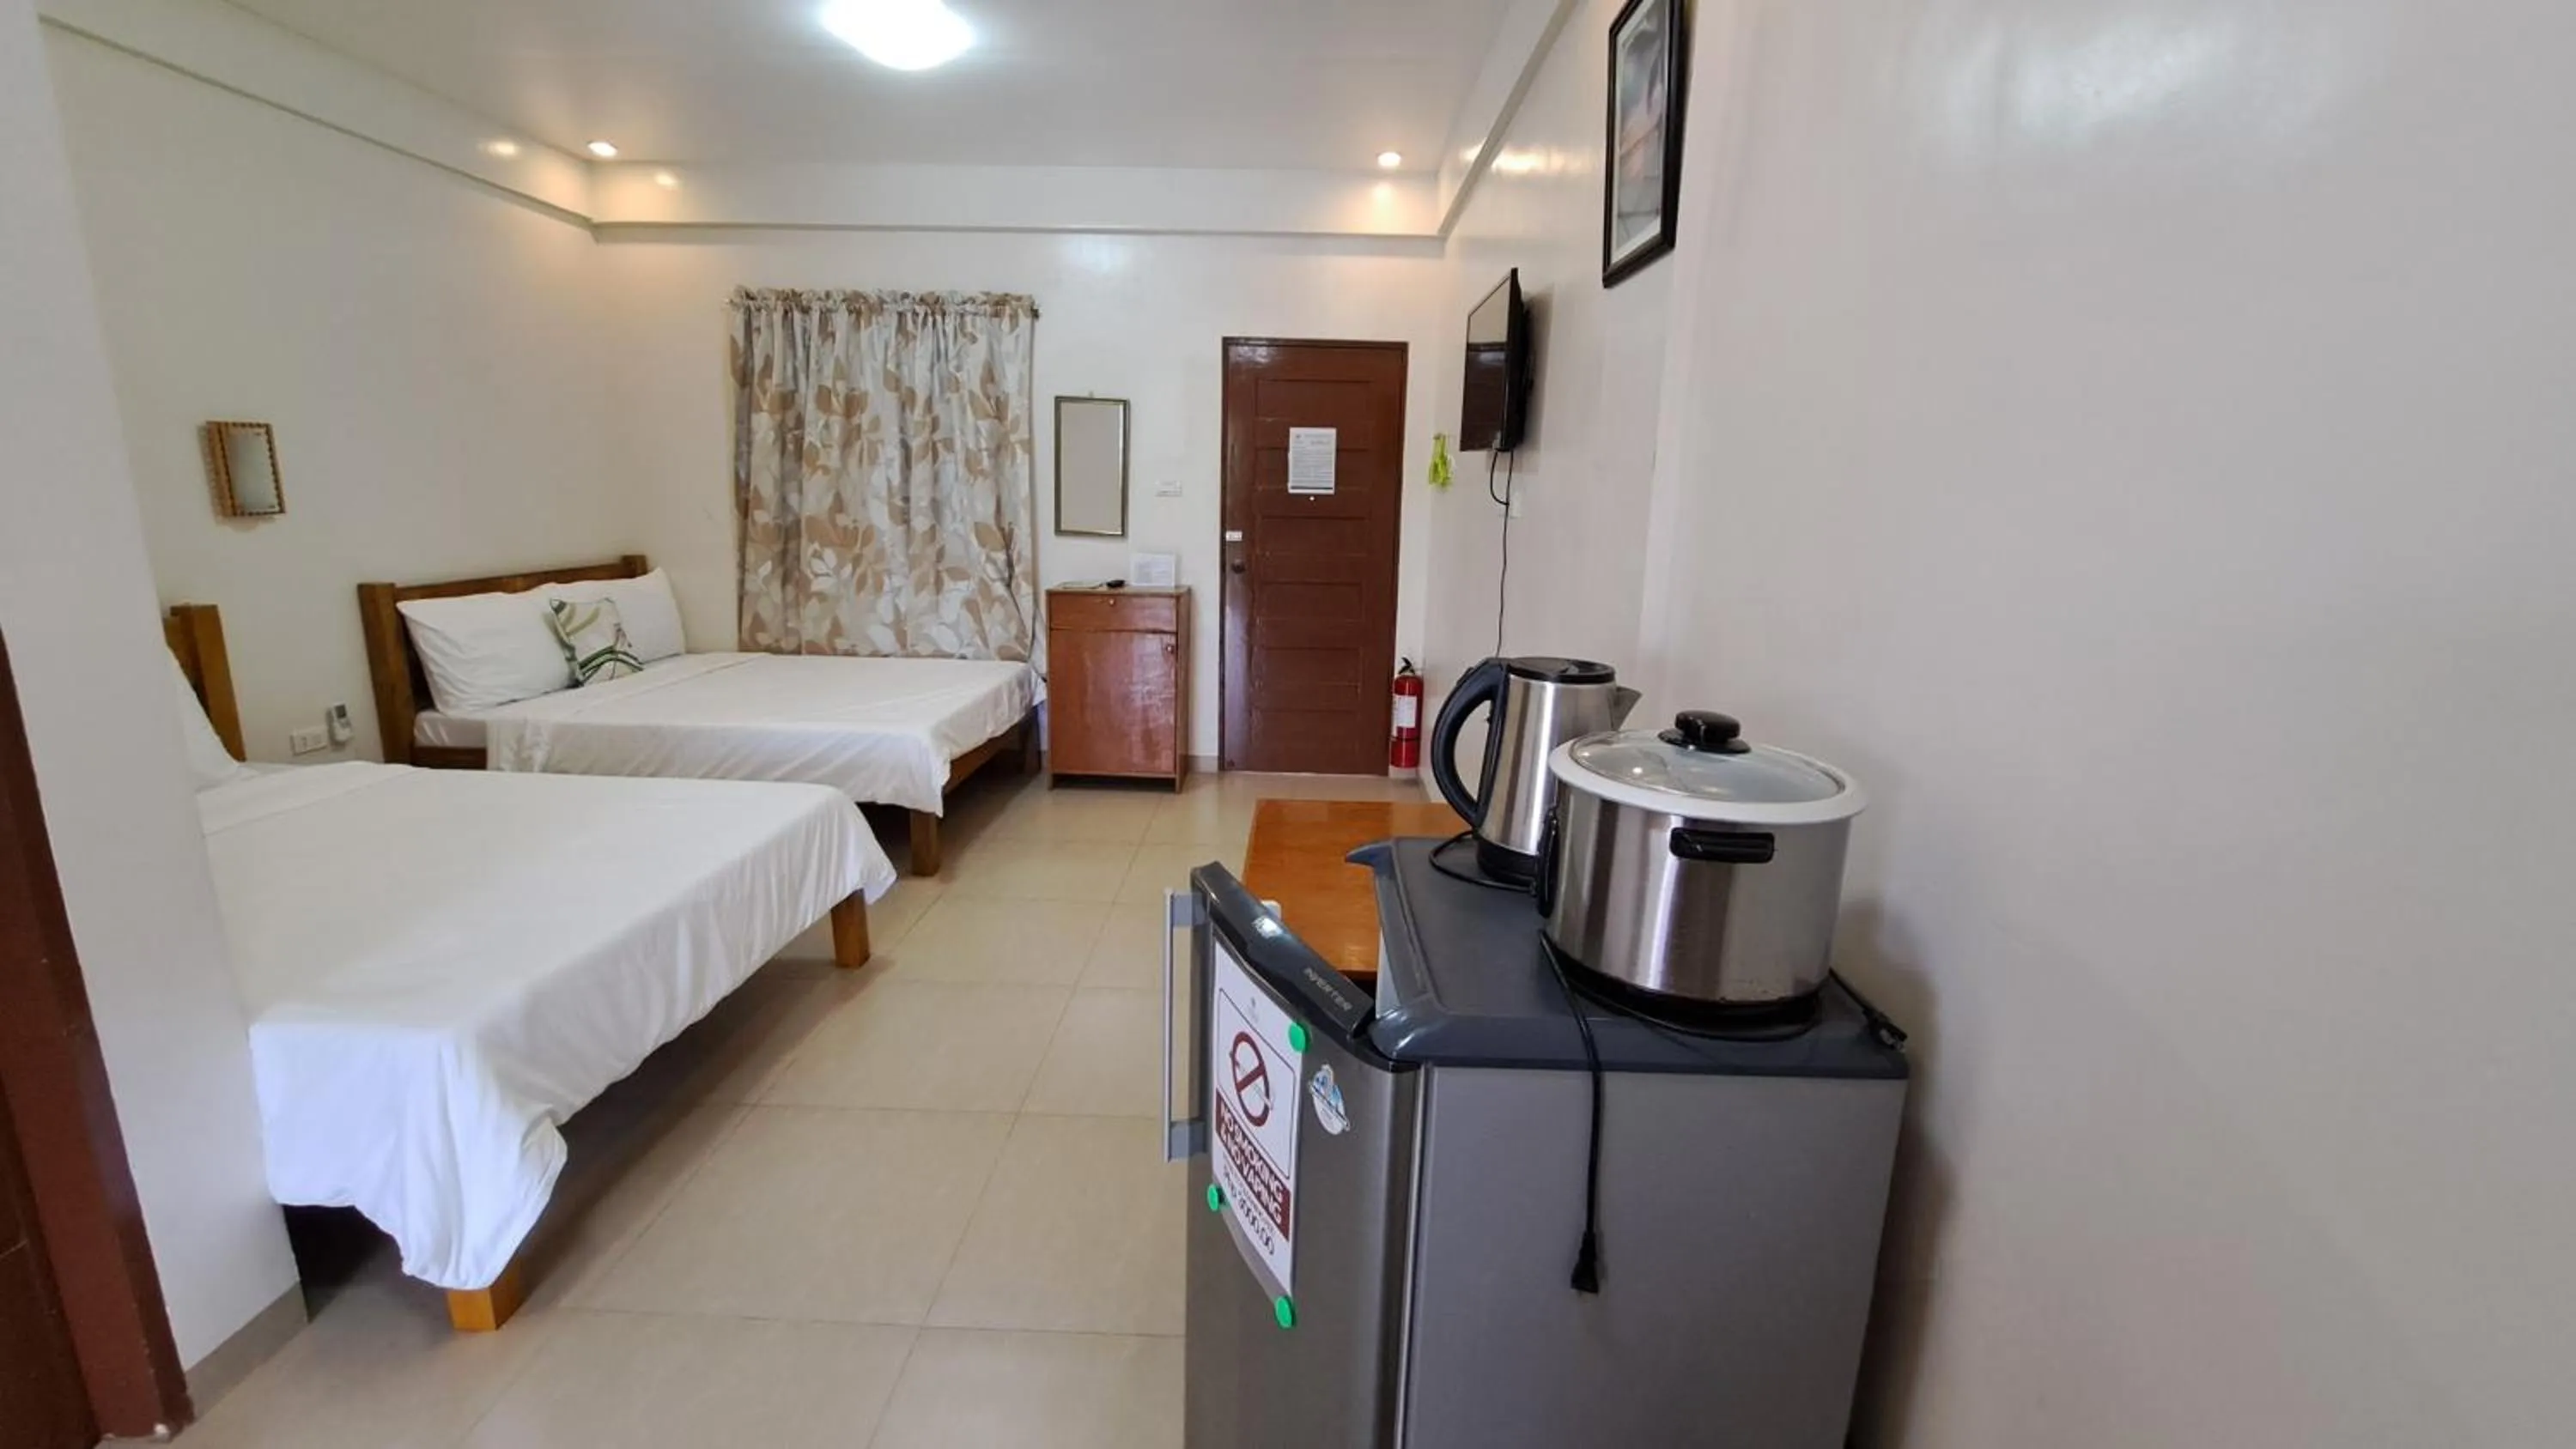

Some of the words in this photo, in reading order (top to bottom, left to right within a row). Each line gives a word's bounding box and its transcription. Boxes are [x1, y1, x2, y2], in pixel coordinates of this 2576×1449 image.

[1220, 1099, 1234, 1133] NO
[1233, 1123, 1283, 1204] SMOKING
[1242, 1155, 1282, 1226] VAPING
